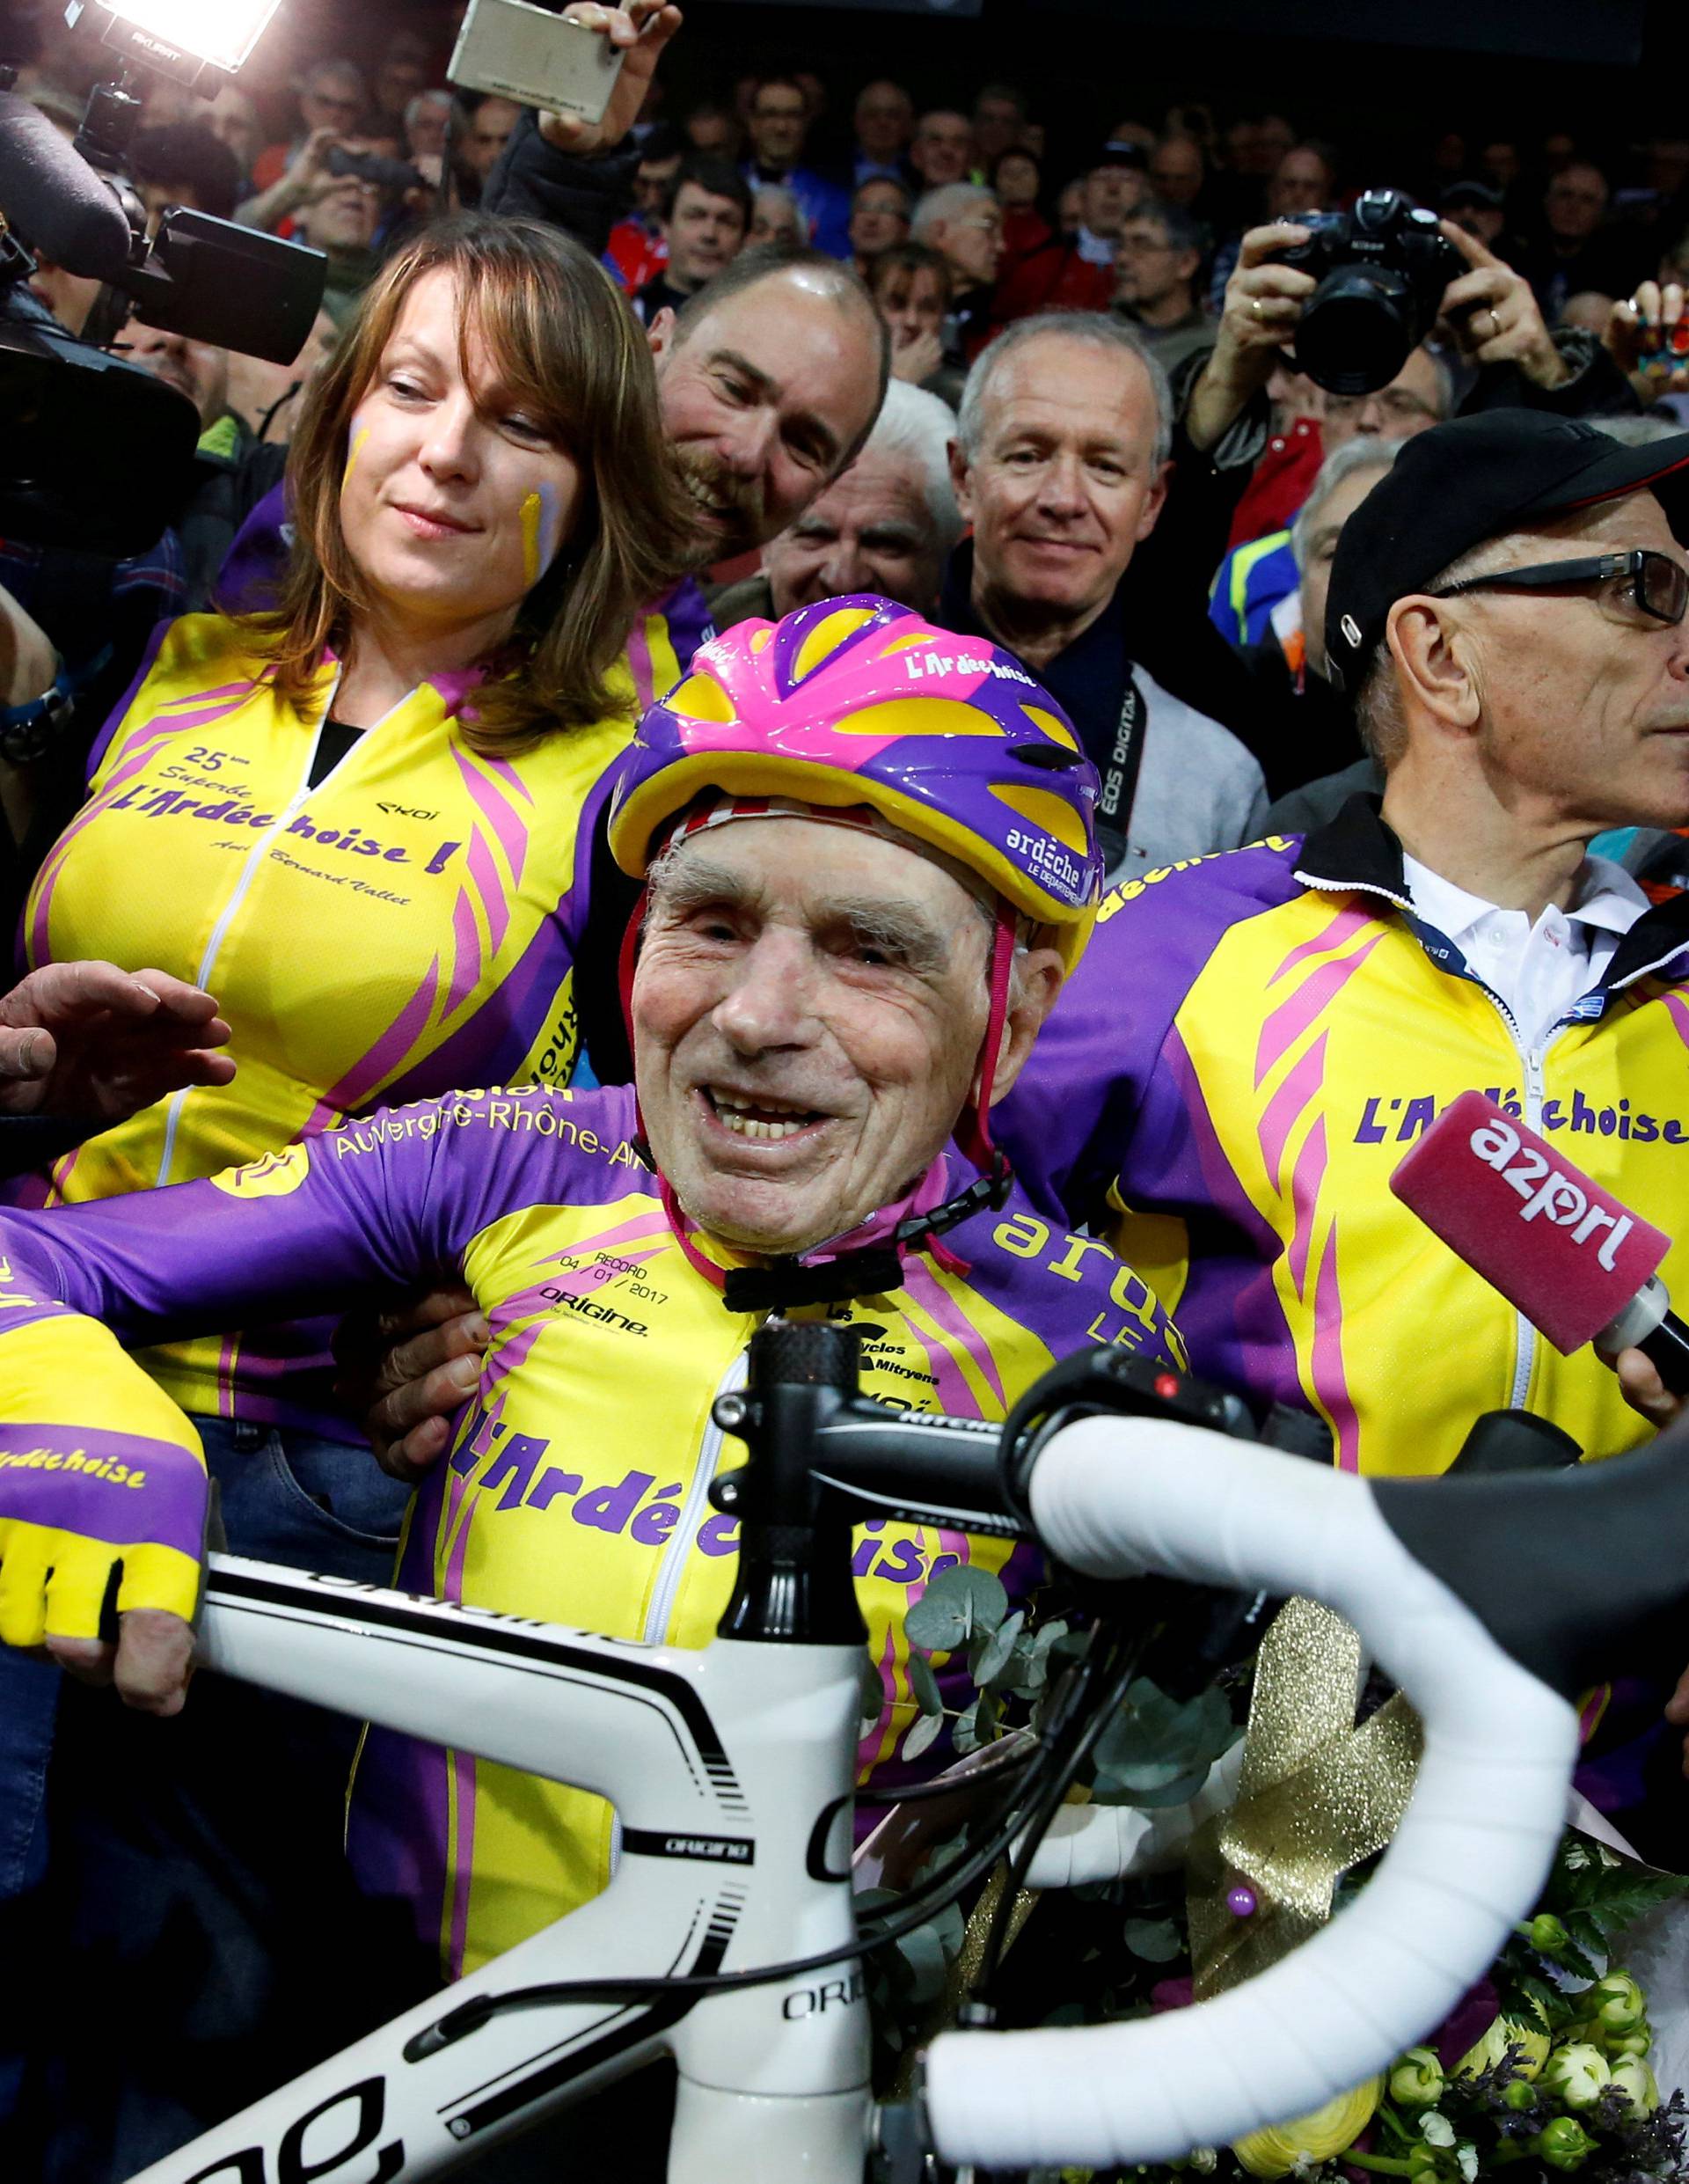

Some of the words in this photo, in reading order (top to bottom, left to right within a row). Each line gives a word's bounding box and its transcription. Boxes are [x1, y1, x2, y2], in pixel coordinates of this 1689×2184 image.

[158, 766, 253, 799] Superbe
[1100, 767, 1124, 815] EOS
[559, 1255, 581, 1271] 04
[594, 1268, 614, 1283] 01
[628, 1282, 669, 1305] 2017
[594, 1251, 648, 1280] RECORD
[874, 1359, 940, 1386] Mitryens
